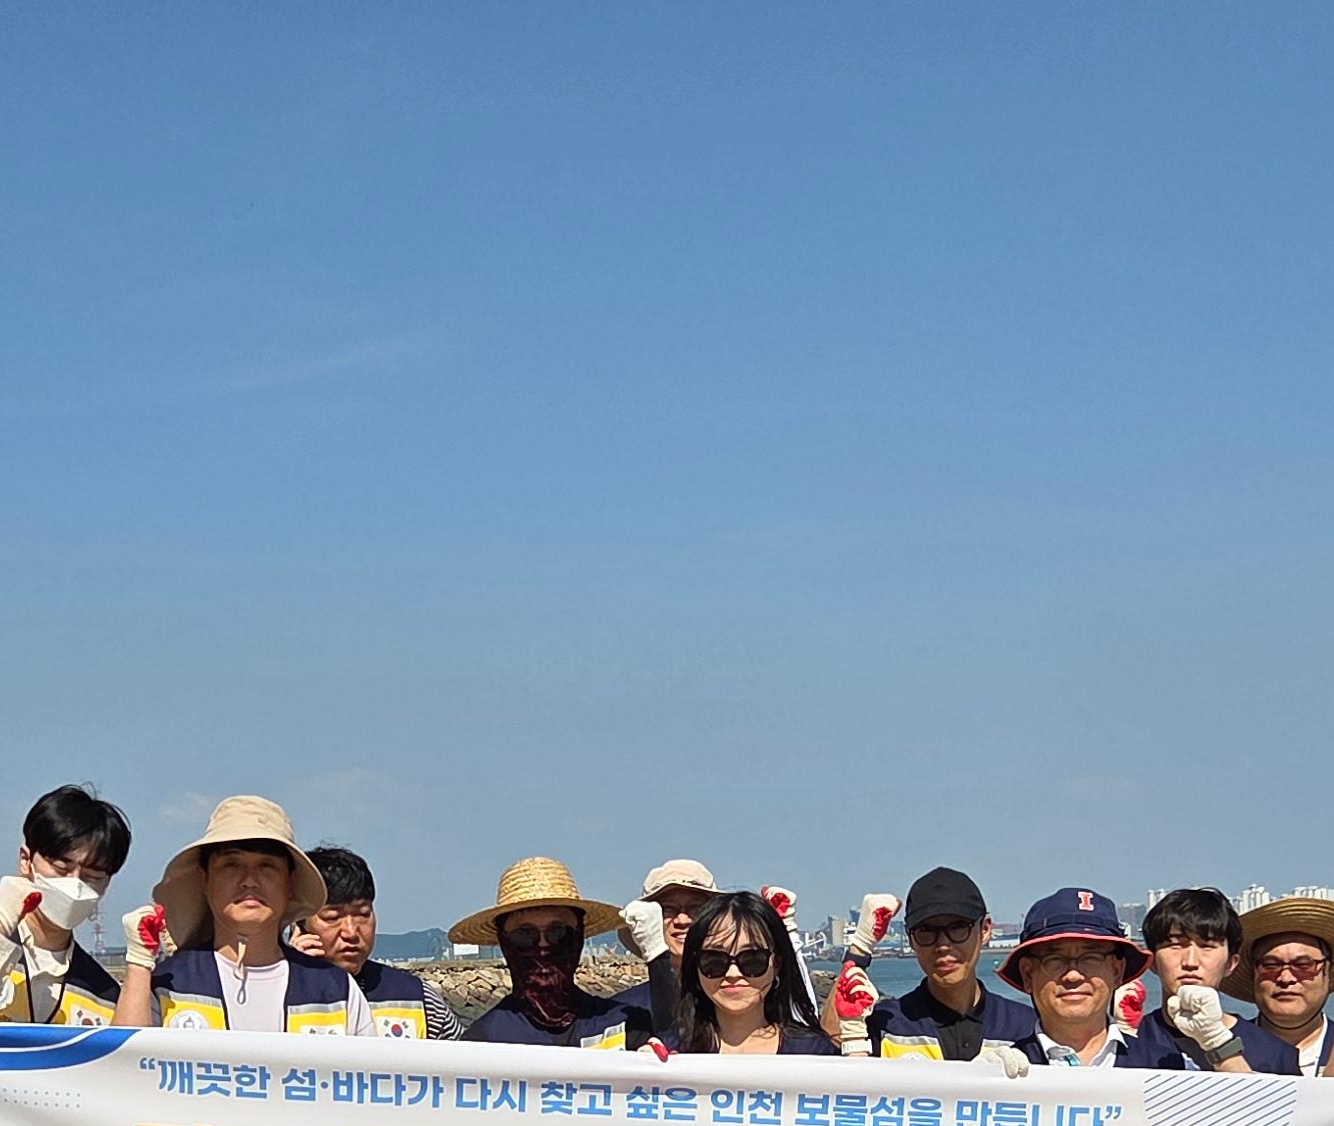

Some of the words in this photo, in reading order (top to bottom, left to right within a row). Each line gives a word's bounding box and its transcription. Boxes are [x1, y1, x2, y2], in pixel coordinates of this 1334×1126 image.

[139, 1057, 271, 1100] “깨끗한
[281, 1068, 445, 1109] 섬·바다가
[455, 1077, 528, 1112] 다시
[540, 1080, 612, 1117] 찾고
[626, 1085, 698, 1121] 싶은
[710, 1089, 784, 1126] 인천
